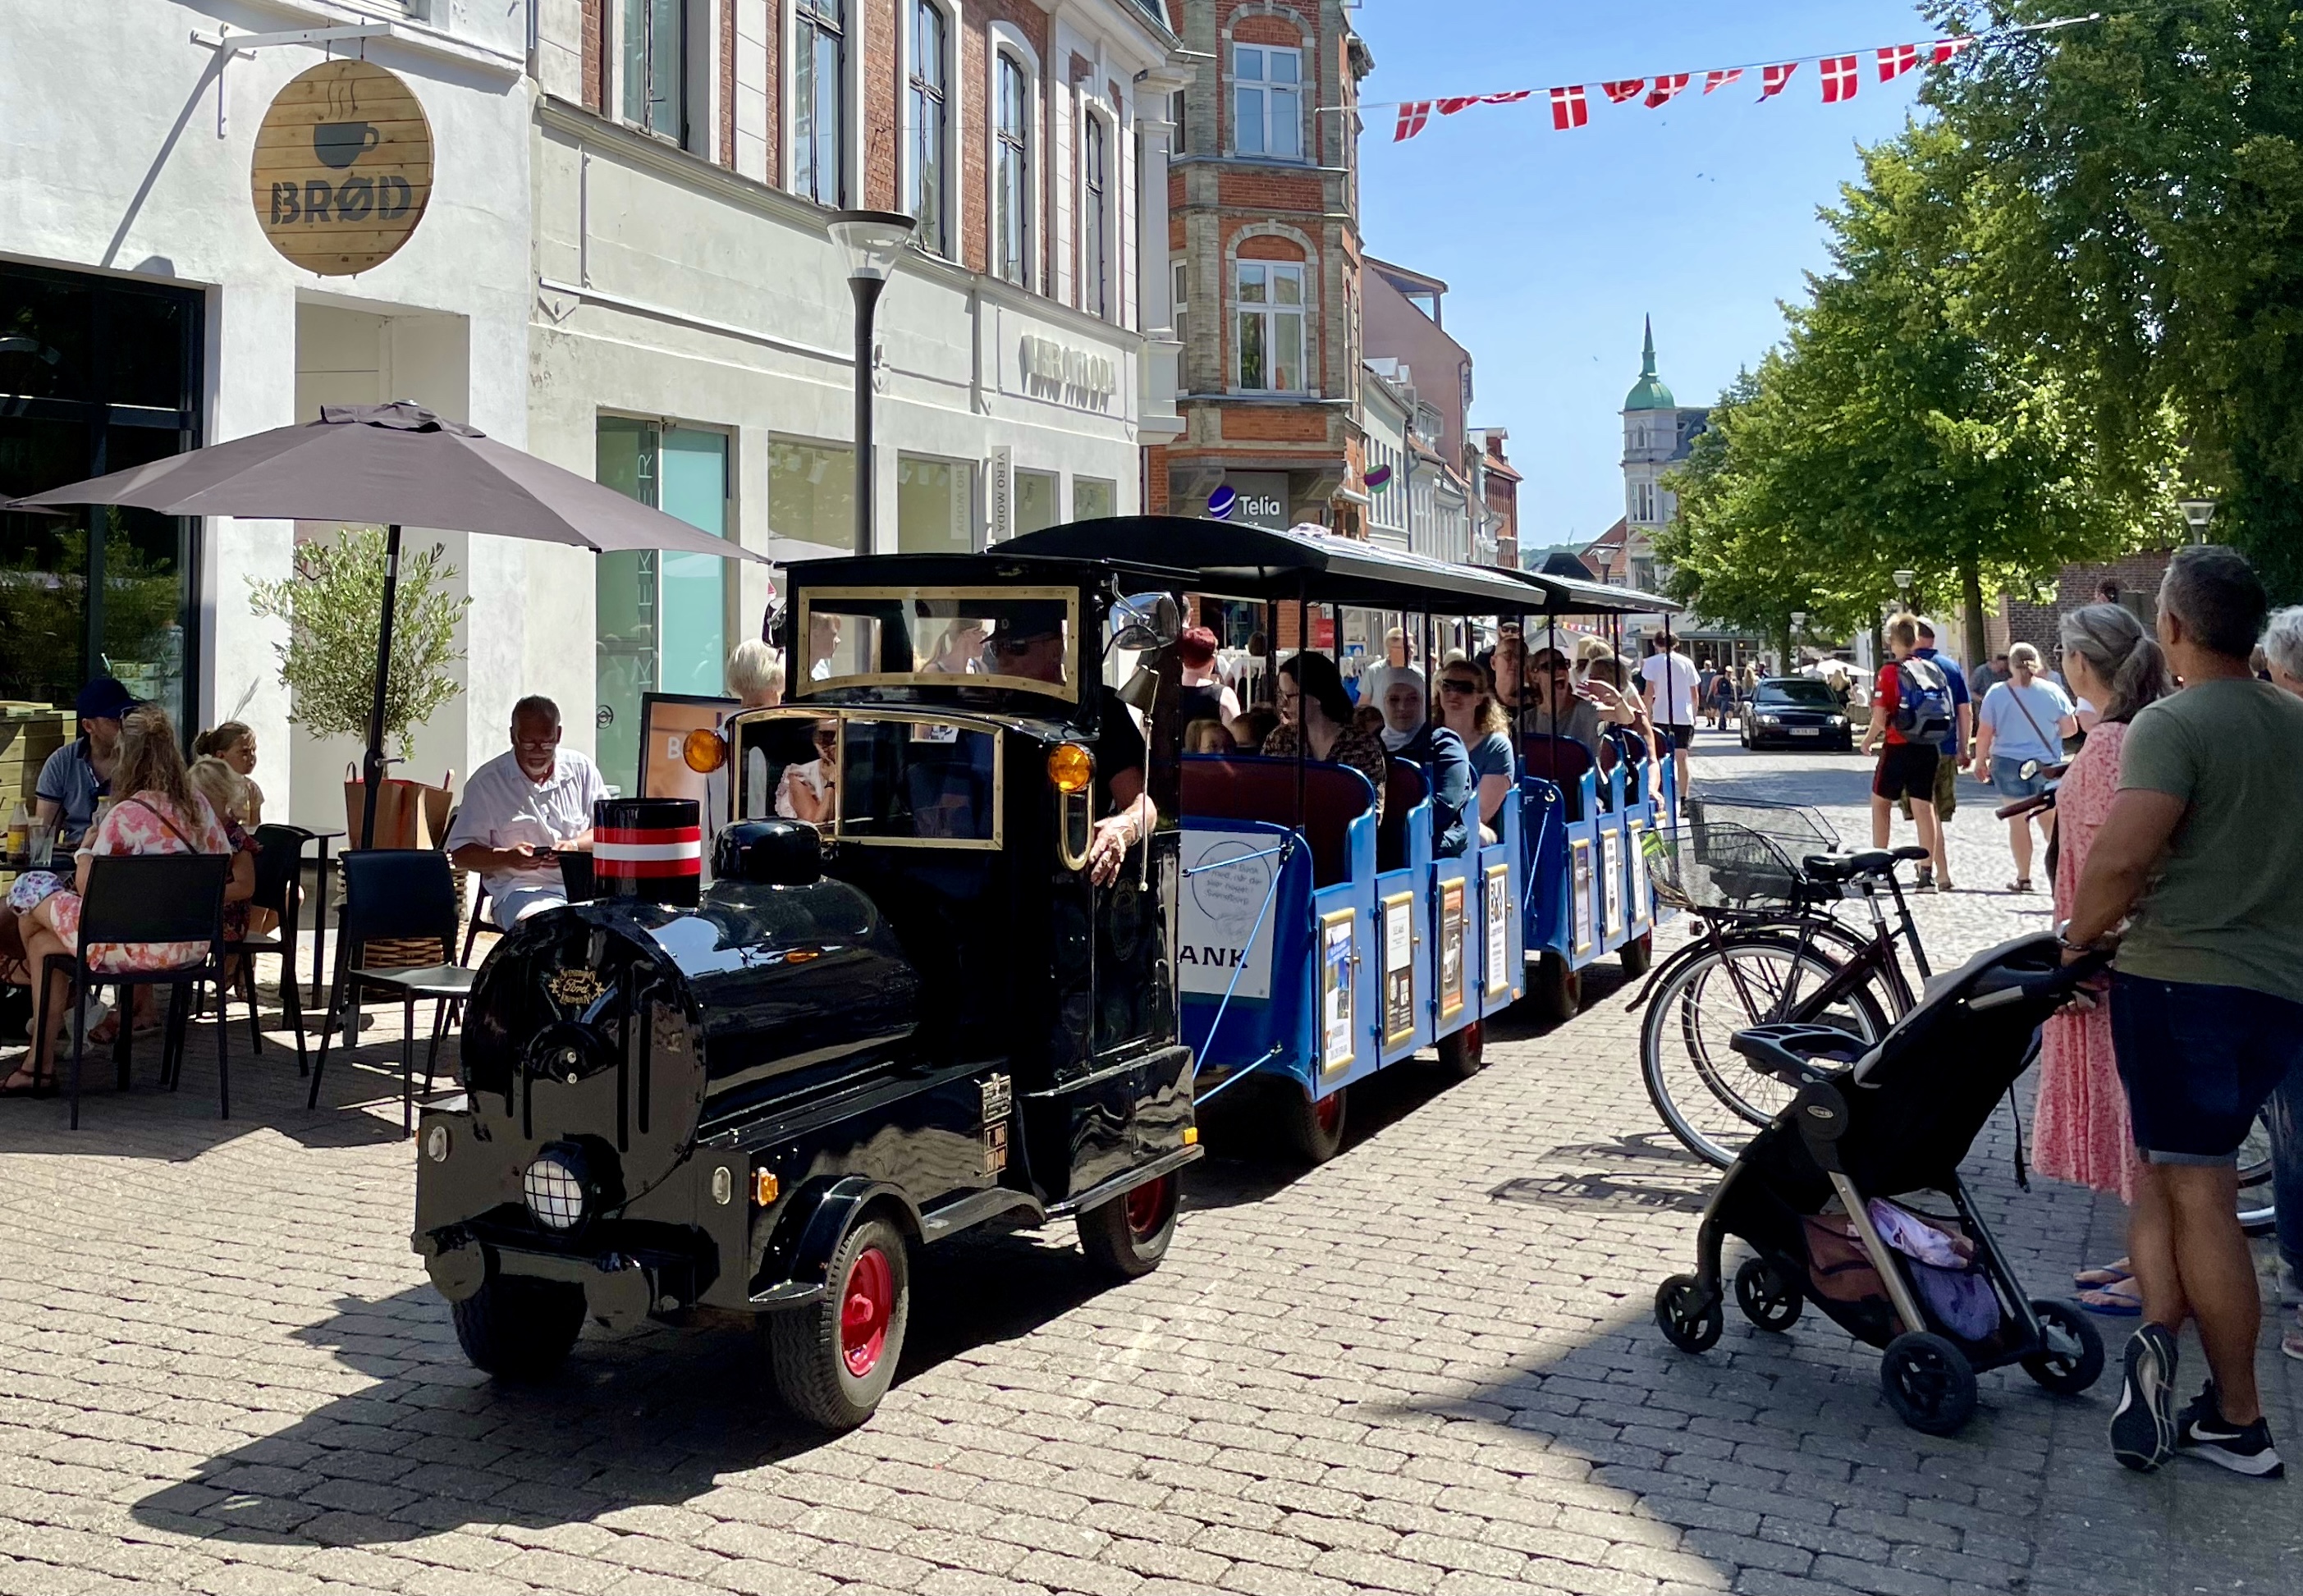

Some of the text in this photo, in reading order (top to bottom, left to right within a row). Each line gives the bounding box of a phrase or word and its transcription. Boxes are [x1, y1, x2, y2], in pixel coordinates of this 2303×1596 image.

[270, 175, 412, 226] BRØD
[1019, 335, 1071, 384] VERO
[997, 452, 1006, 532] VERO MODA
[1238, 496, 1280, 516] Telia
[637, 453, 653, 736] KITEKER
[1179, 945, 1248, 968] ANK
